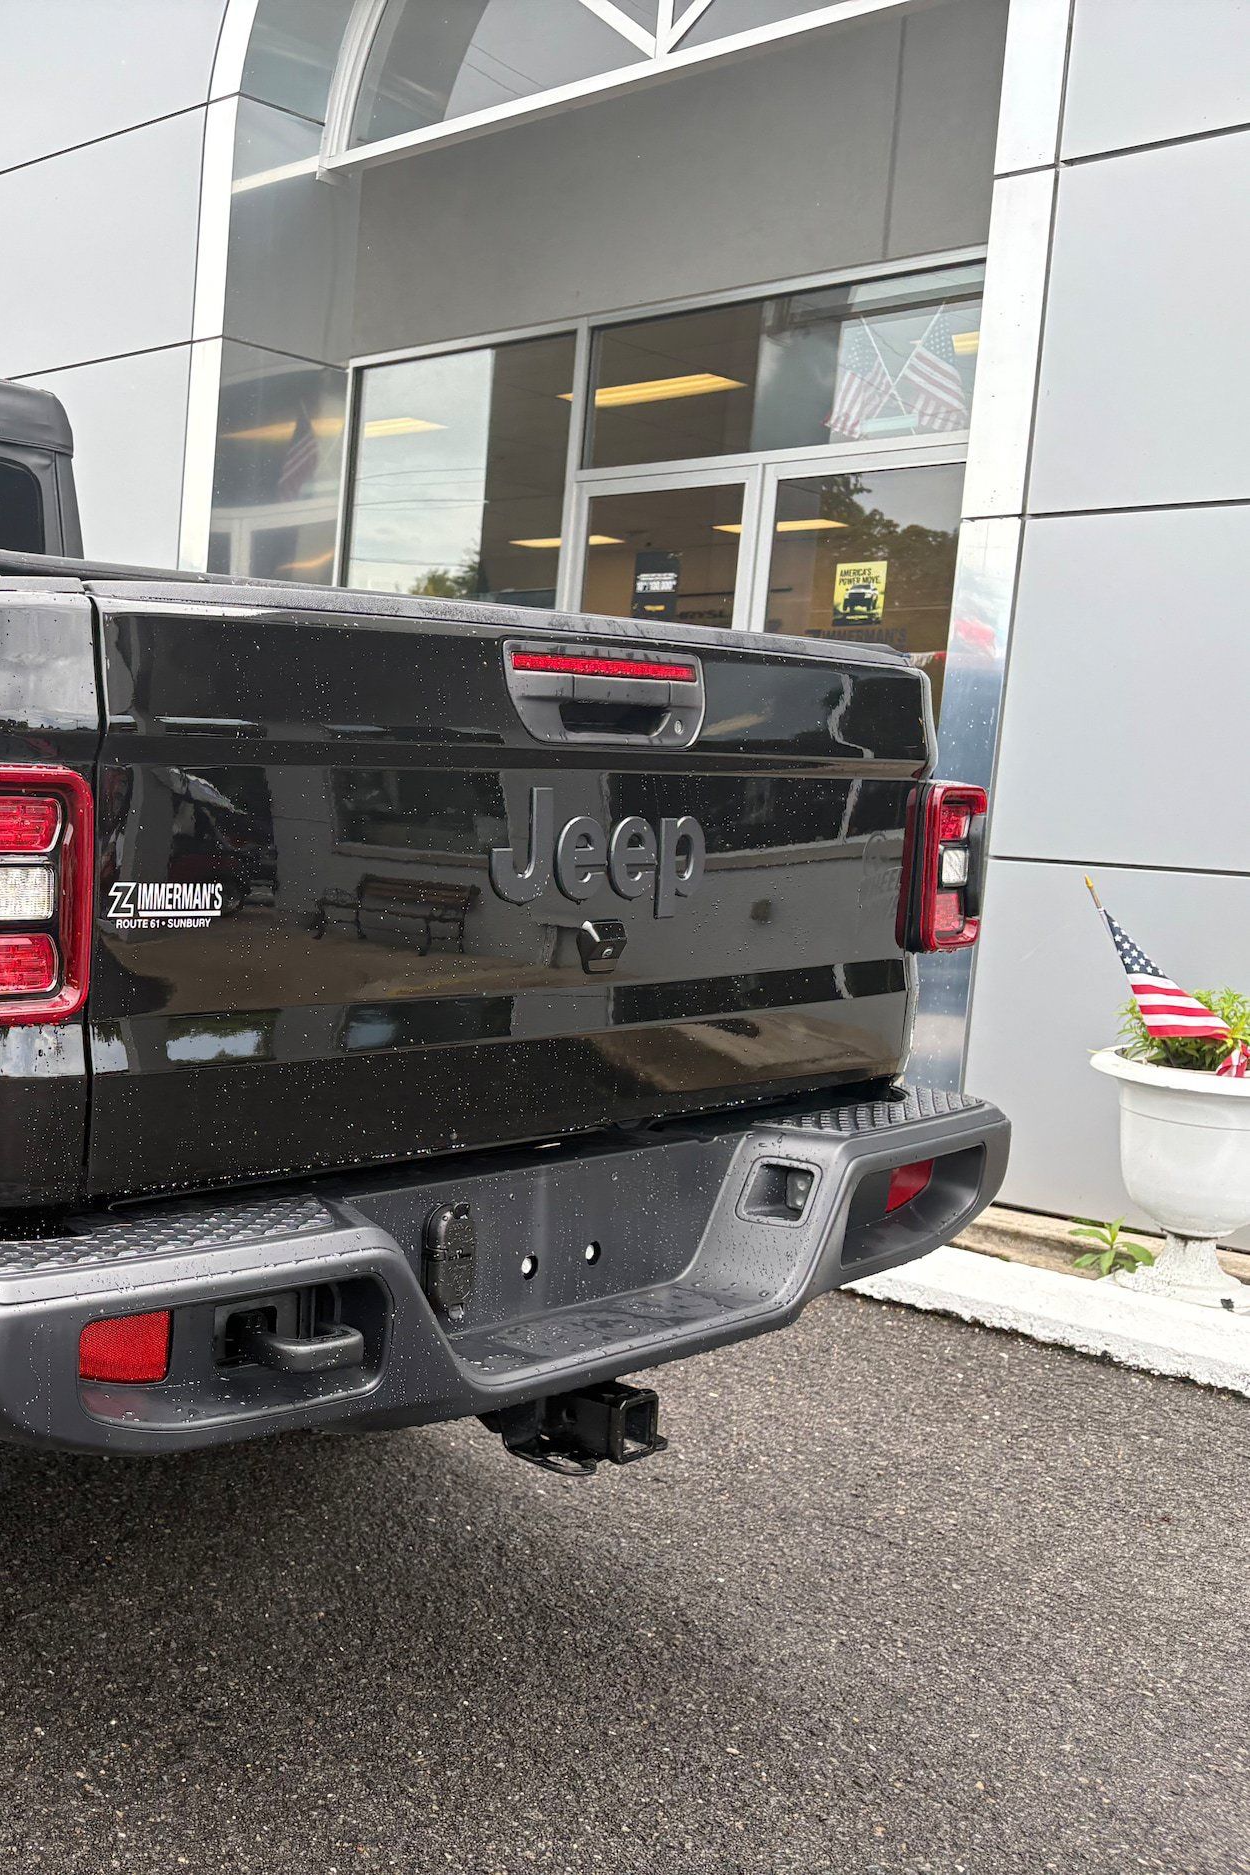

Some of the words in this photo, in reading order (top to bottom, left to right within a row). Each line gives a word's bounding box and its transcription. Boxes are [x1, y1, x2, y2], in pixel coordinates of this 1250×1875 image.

[840, 568, 872, 577] AMERICA'S
[839, 577, 861, 586] POWER
[489, 787, 705, 919] Jeep
[107, 881, 223, 918] ZIMMERMAN'S
[116, 918, 148, 929] ROUTE
[150, 918, 160, 929] 61
[167, 917, 212, 928] SUNBURY
